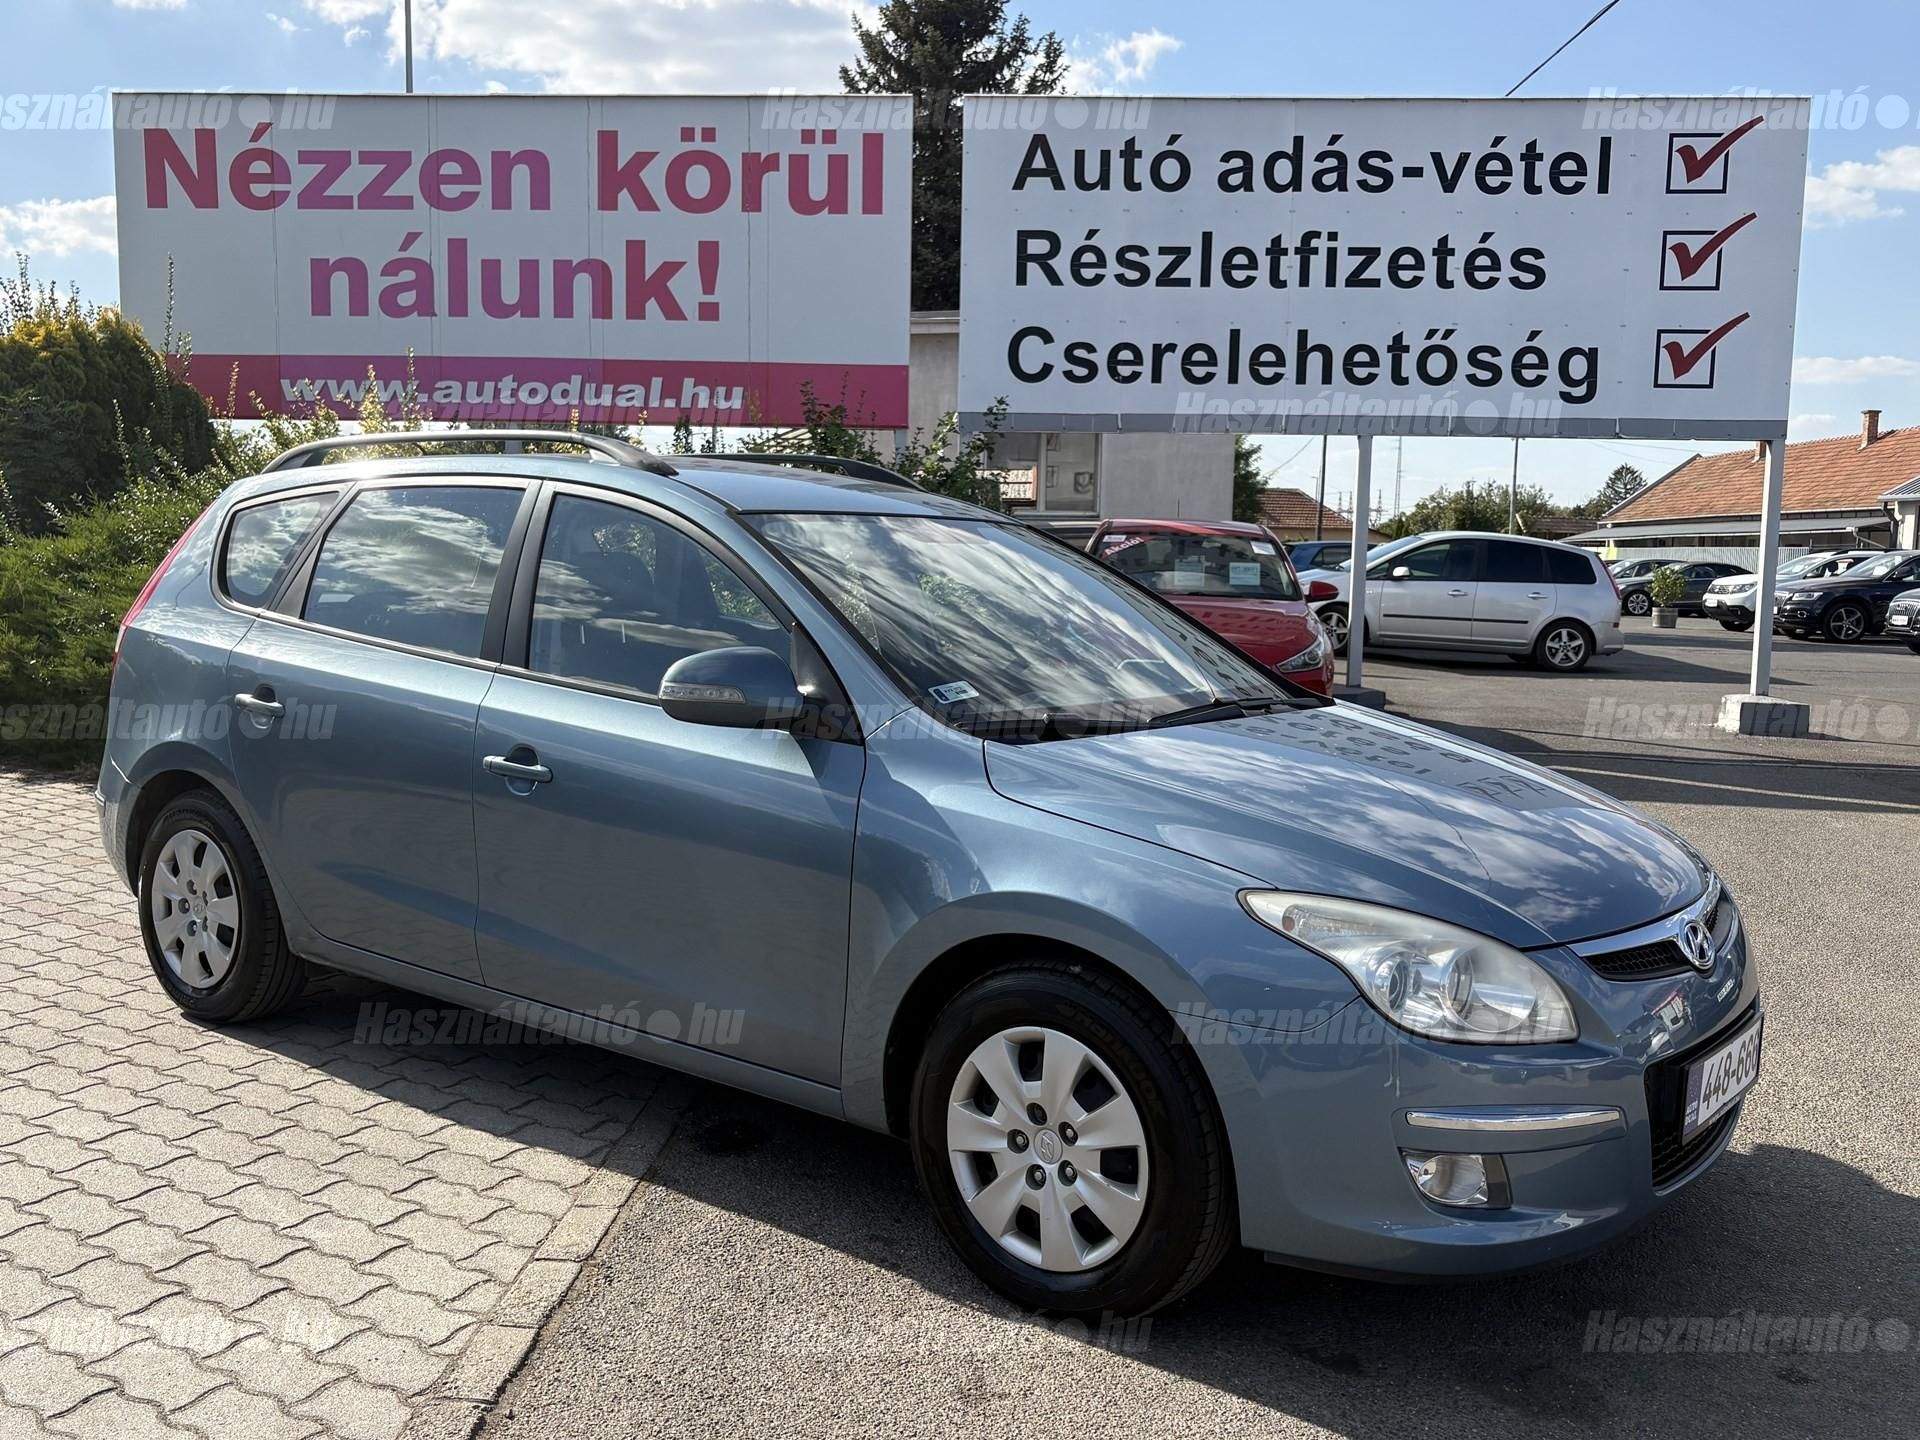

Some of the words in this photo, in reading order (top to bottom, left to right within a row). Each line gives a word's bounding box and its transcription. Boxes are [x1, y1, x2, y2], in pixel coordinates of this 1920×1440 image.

[143, 122, 551, 211] Nézzen
[596, 126, 884, 215] körül
[1011, 133, 1192, 193] Autó
[1216, 134, 1612, 195] adás-vétel
[310, 231, 720, 322] nálunk!
[1014, 229, 1547, 291] Részletfizetés
[280, 374, 745, 410] www.autodual.hu
[1007, 326, 1599, 404] Cserelehetőség
